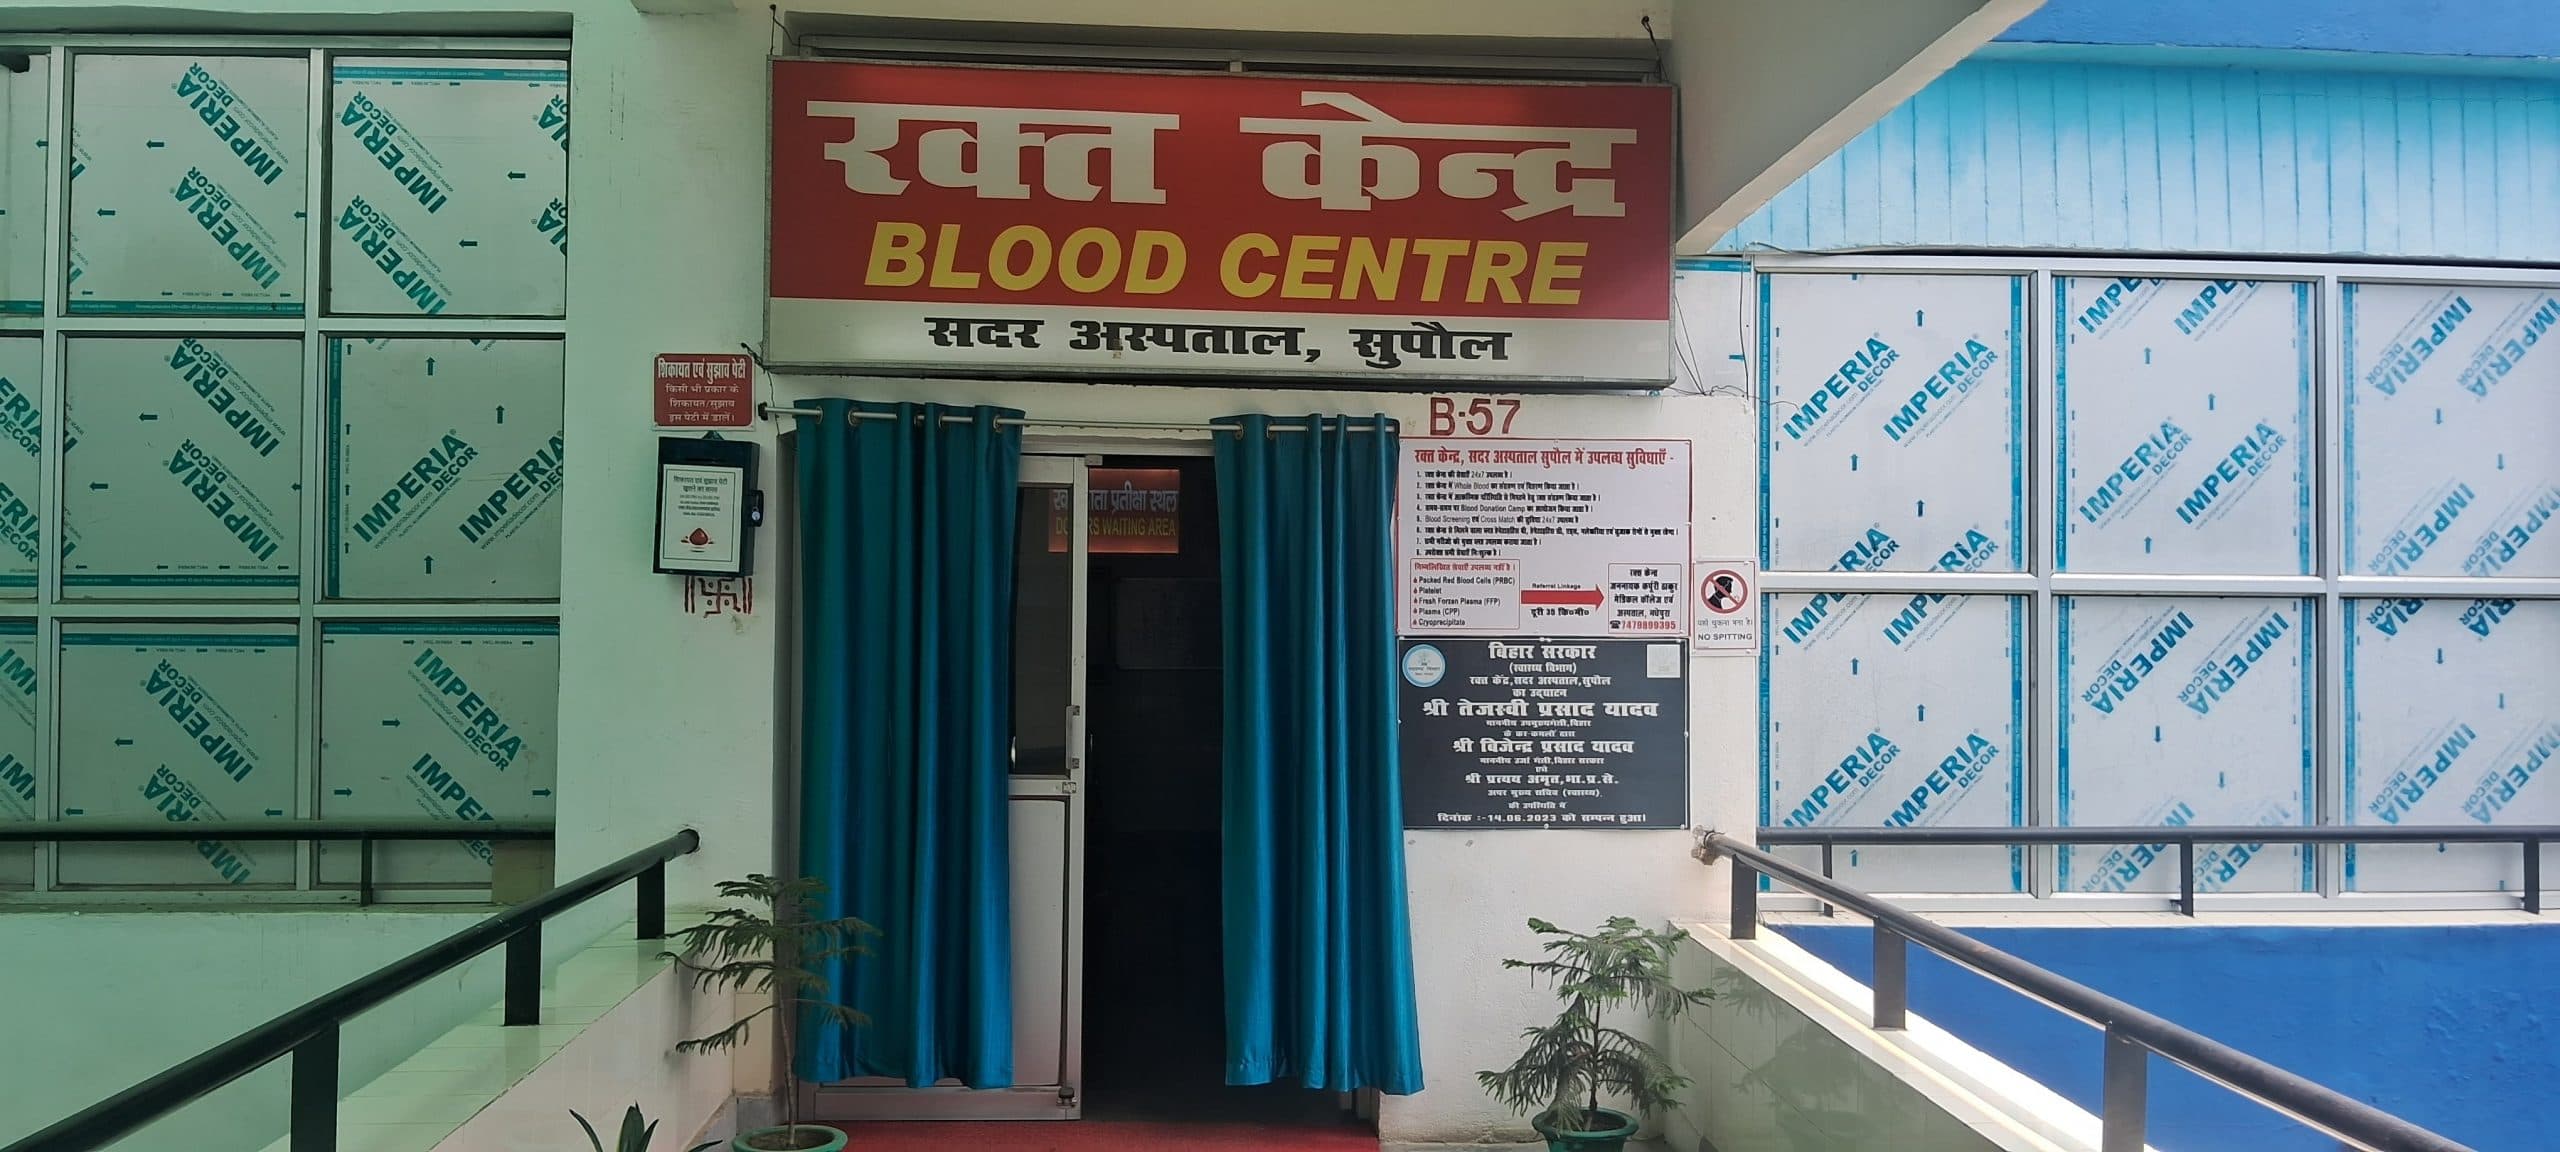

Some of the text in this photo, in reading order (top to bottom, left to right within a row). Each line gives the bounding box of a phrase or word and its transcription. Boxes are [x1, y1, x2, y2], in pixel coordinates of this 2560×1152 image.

[176, 72, 283, 185] IMPERIA
[353, 91, 398, 136] DECOR
[340, 100, 447, 214] IMPERIA
[806, 90, 1637, 222] रक्त केन्द्र
[174, 177, 280, 290] IMPERIA
[351, 194, 396, 239] DECOR
[338, 205, 446, 314] IMPERIA
[864, 221, 1589, 305] BLOOD CENTRE
[182, 337, 229, 380] DECOR
[924, 317, 1513, 370] सदर अस्पताल, सुपौल
[2376, 295, 2473, 396] IMPERIA
[658, 358, 746, 384] शिकायत एवं सुझाव पेटी
[690, 383, 702, 393] भी
[703, 385, 727, 393] प्रकार
[1783, 337, 1890, 440] IMPERIA
[1858, 349, 1900, 393] DECOR
[1883, 339, 1989, 442] IMPERIA
[169, 345, 280, 457] IMPERIA
[1429, 397, 1521, 436] B-57
[181, 438, 227, 483] DECOR
[1414, 450, 1435, 463] रक्त
[1438, 446, 1464, 465] केन्द्र,
[1468, 450, 1491, 463] सदर
[1493, 450, 1538, 464] अस्पताल
[1540, 447, 1572, 469] सुपौल
[1574, 447, 1586, 464] में
[1587, 451, 1623, 465] उपलब्ध
[2080, 421, 2183, 524] IMPERIA
[2176, 422, 2277, 524] IMPERIA
[2248, 434, 2287, 477] DECOR
[168, 449, 279, 562] IMPERIA
[353, 434, 467, 543] IMPERIA
[1508, 505, 1525, 513] Camp
[1102, 518, 1147, 536] WAITING
[1148, 518, 1176, 536] AREA
[1442, 516, 1470, 524] Screening
[1484, 598, 1501, 606] (FFP)
[1492, 577, 1515, 586] (PRBC)
[1442, 608, 1460, 616] (CPP)
[1488, 641, 1597, 659] बिहार सरकार
[2091, 611, 2195, 714] IMPERIA
[2186, 612, 2289, 715] IMPERIA
[158, 658, 203, 704] DECOR
[1512, 688, 1526, 697] का
[2177, 660, 2218, 702] DECOR
[145, 669, 253, 783] IMPERIA
[414, 648, 521, 761] IMPERIA
[1422, 699, 1659, 716] श्री तेजस्वी प्रसाद यादव
[1453, 738, 1474, 752] श्री
[1540, 741, 1585, 753] प्रसाद
[1591, 741, 1634, 753] यादव
[1859, 743, 1900, 787] DECOR
[1465, 773, 1481, 784] श्री
[2369, 771, 2407, 813] DECOR
[2378, 723, 2477, 825] IMPERIA
[1437, 812, 1472, 822] दिनांक
[1561, 813, 1576, 822] को
